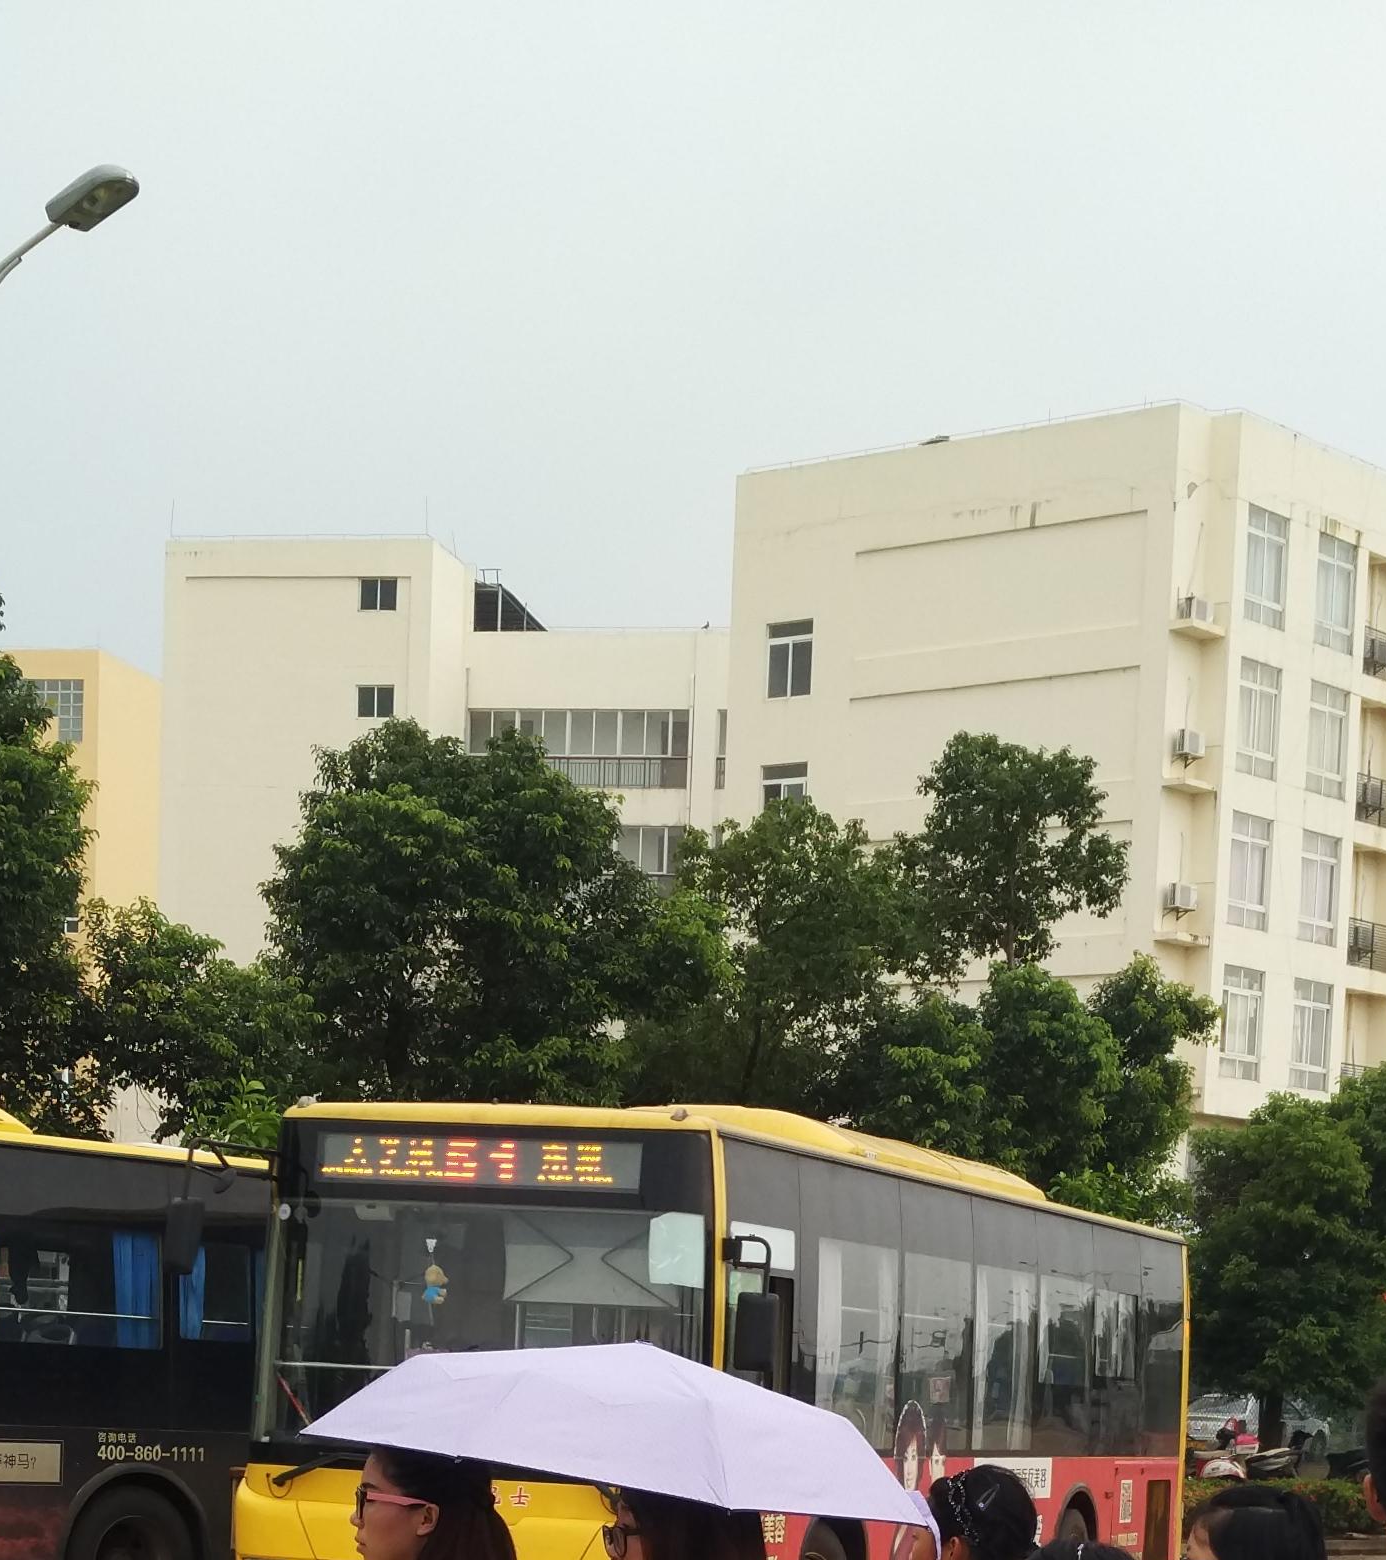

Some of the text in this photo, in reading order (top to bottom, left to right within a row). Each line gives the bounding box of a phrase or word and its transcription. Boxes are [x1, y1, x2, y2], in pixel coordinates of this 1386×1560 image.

[97, 1432, 137, 1444] 咨询电话
[97, 1444, 205, 1462] 400-860-1111
